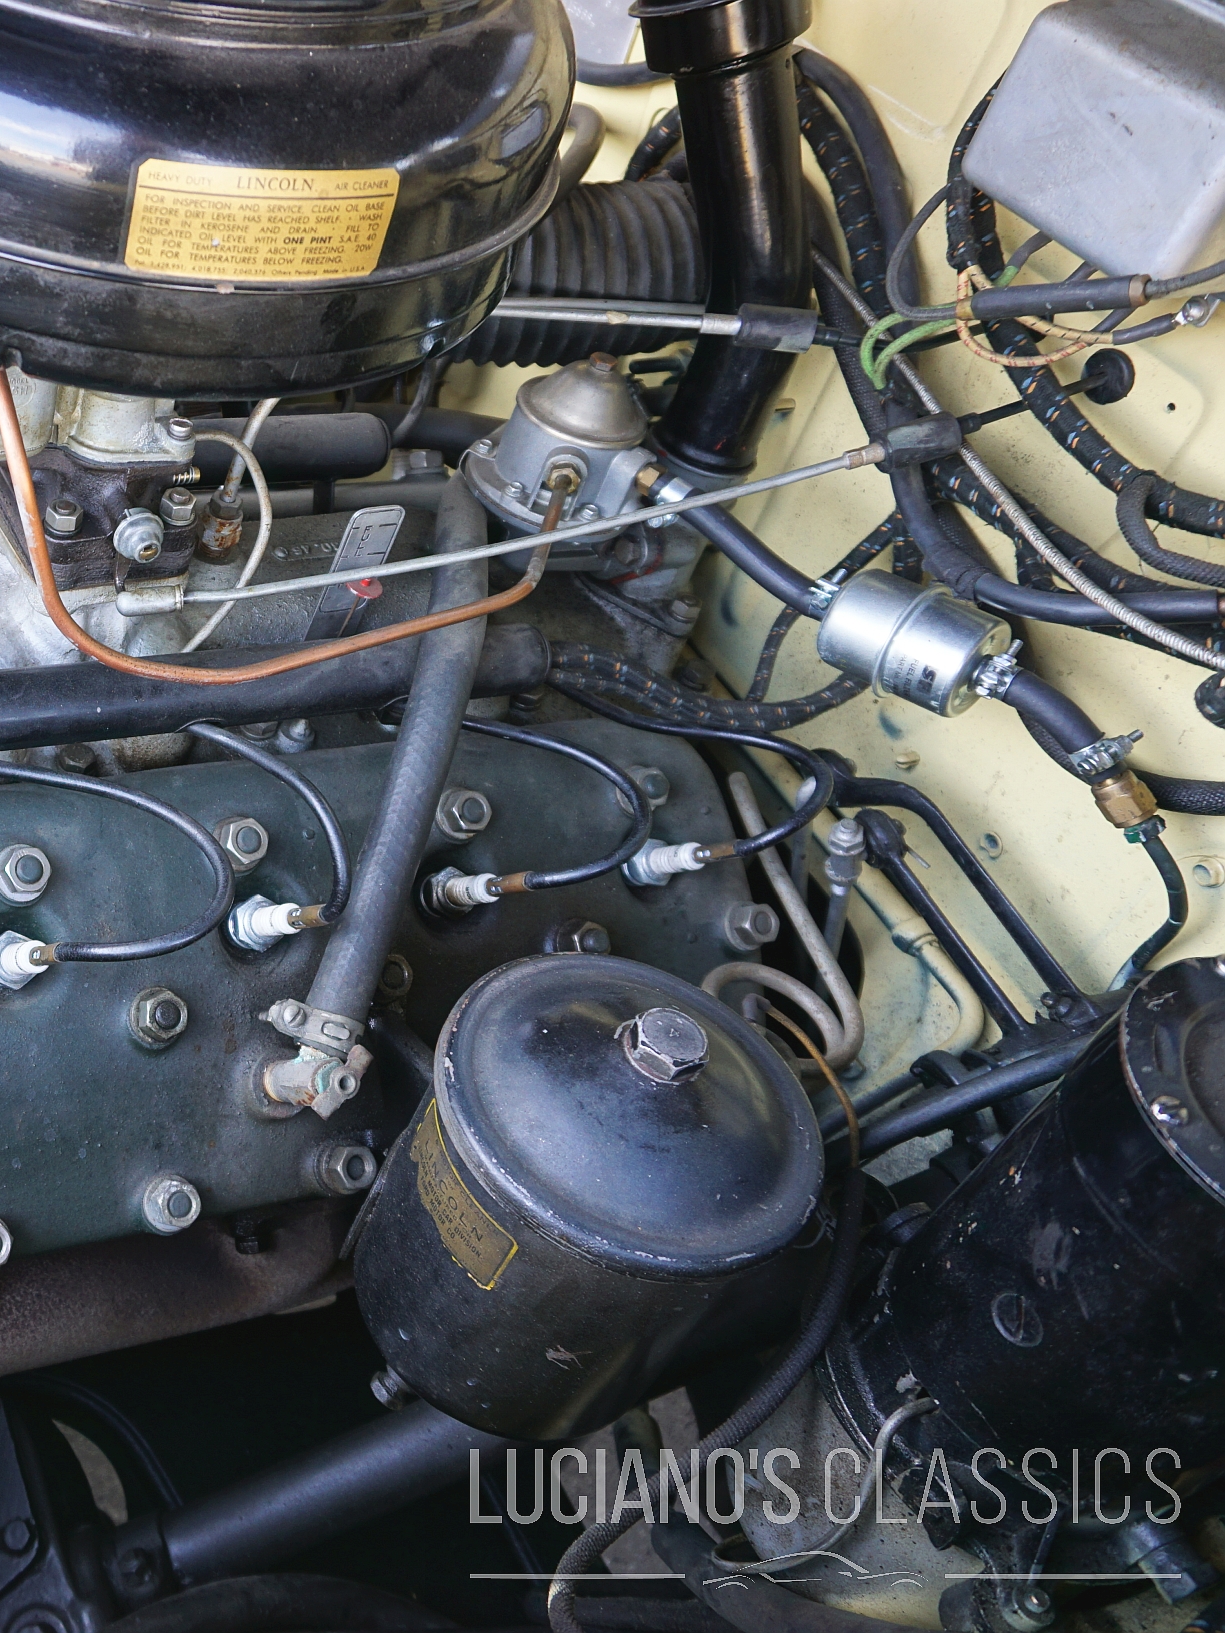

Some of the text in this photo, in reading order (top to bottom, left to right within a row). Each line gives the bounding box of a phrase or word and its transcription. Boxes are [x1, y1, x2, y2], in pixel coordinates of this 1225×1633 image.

[148, 171, 180, 182] HEAVY
[186, 176, 213, 186] DUTY
[335, 182, 349, 191] AIR
[353, 180, 389, 191] CLEANER
[145, 193, 165, 203] FOR
[173, 197, 232, 210] INSPECTION
[238, 203, 260, 212] AND
[311, 204, 340, 213] CLEAN
[345, 203, 359, 212] OIL
[365, 201, 385, 211] BASE
[142, 204, 180, 217] BEFORE
[184, 209, 206, 219] DIRT
[212, 211, 237, 222] LEVEL
[243, 214, 262, 223] HAS
[267, 215, 310, 224] REACHED
[359, 213, 383, 221] WASH
[141, 215, 171, 226] FILTER
[180, 220, 192, 228] IN
[200, 222, 250, 233] KEROSENE
[260, 226, 280, 234] AND
[346, 225, 361, 233] FILL
[368, 223, 380, 231] TO
[137, 235, 153, 245] OIL
[162, 238, 183, 248] FOR
[191, 242, 260, 254] TEMPERATURES
[266, 247, 298, 255] ABOVE
[355, 244, 374, 253] 20W
[139, 226, 192, 239] INDICATED
[199, 231, 213, 241] OIL
[222, 234, 246, 243] LEVEL
[254, 236, 278, 244] WITH
[283, 236, 305, 244] ONE
[310, 236, 333, 244] PINT
[366, 233, 377, 241] 40
[136, 246, 152, 256] OIL
[160, 249, 180, 259] FOR
[189, 252, 257, 265] TEMPERATURES
[263, 257, 295, 265] BELOW
[425, 1138, 484, 1242] LINCOLN
[427, 1180, 442, 1208] MOTOR
[441, 1208, 454, 1226] CAR
[453, 1225, 482, 1259] DIVISION
[429, 1198, 446, 1226] MOTOR
